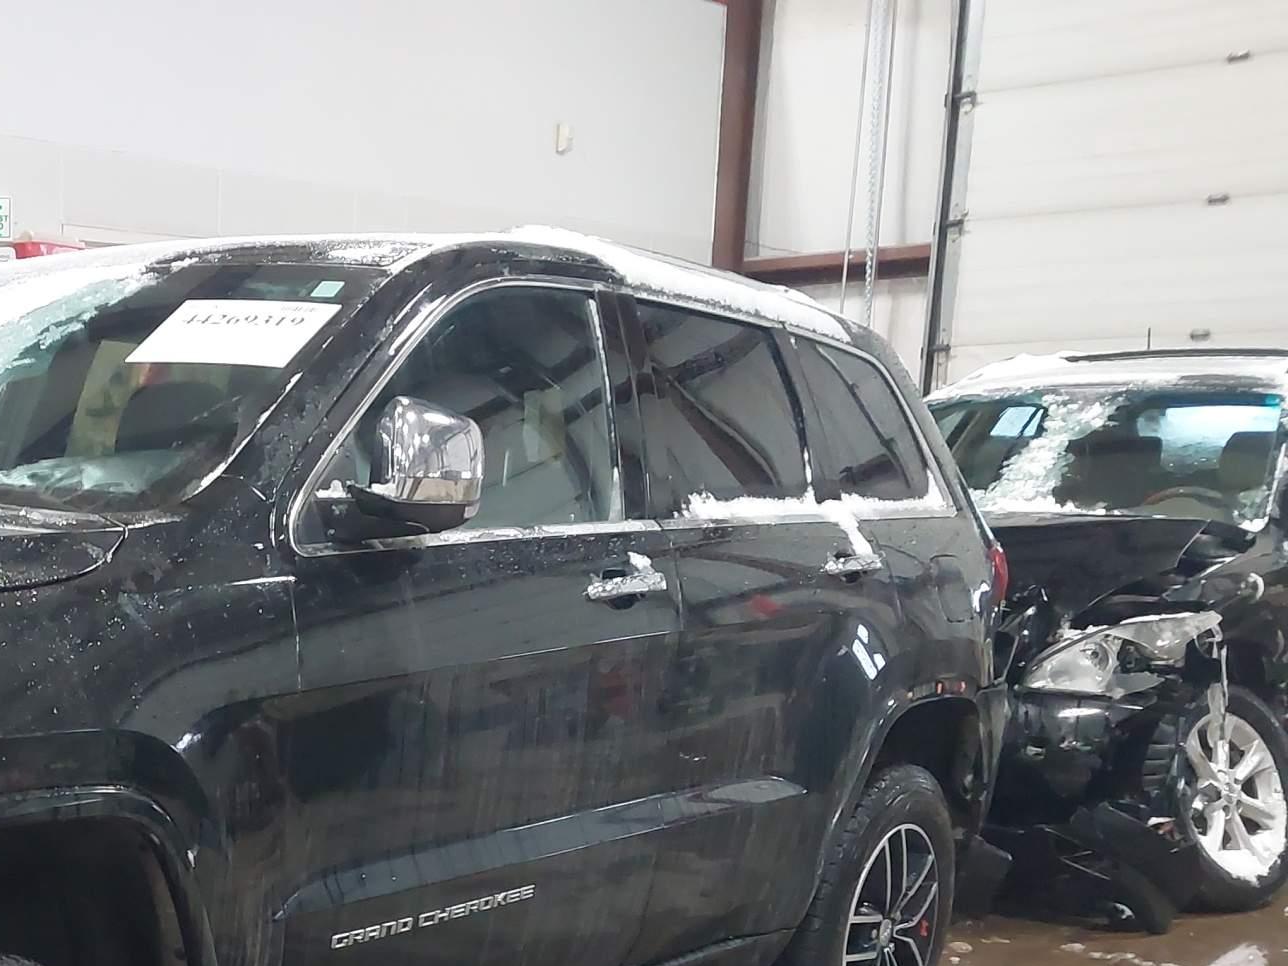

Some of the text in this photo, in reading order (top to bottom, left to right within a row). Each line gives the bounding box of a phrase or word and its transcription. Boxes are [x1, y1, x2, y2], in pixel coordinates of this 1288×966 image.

[183, 313, 305, 327] 44269319
[330, 884, 536, 950] GRAND CHEROKEE
